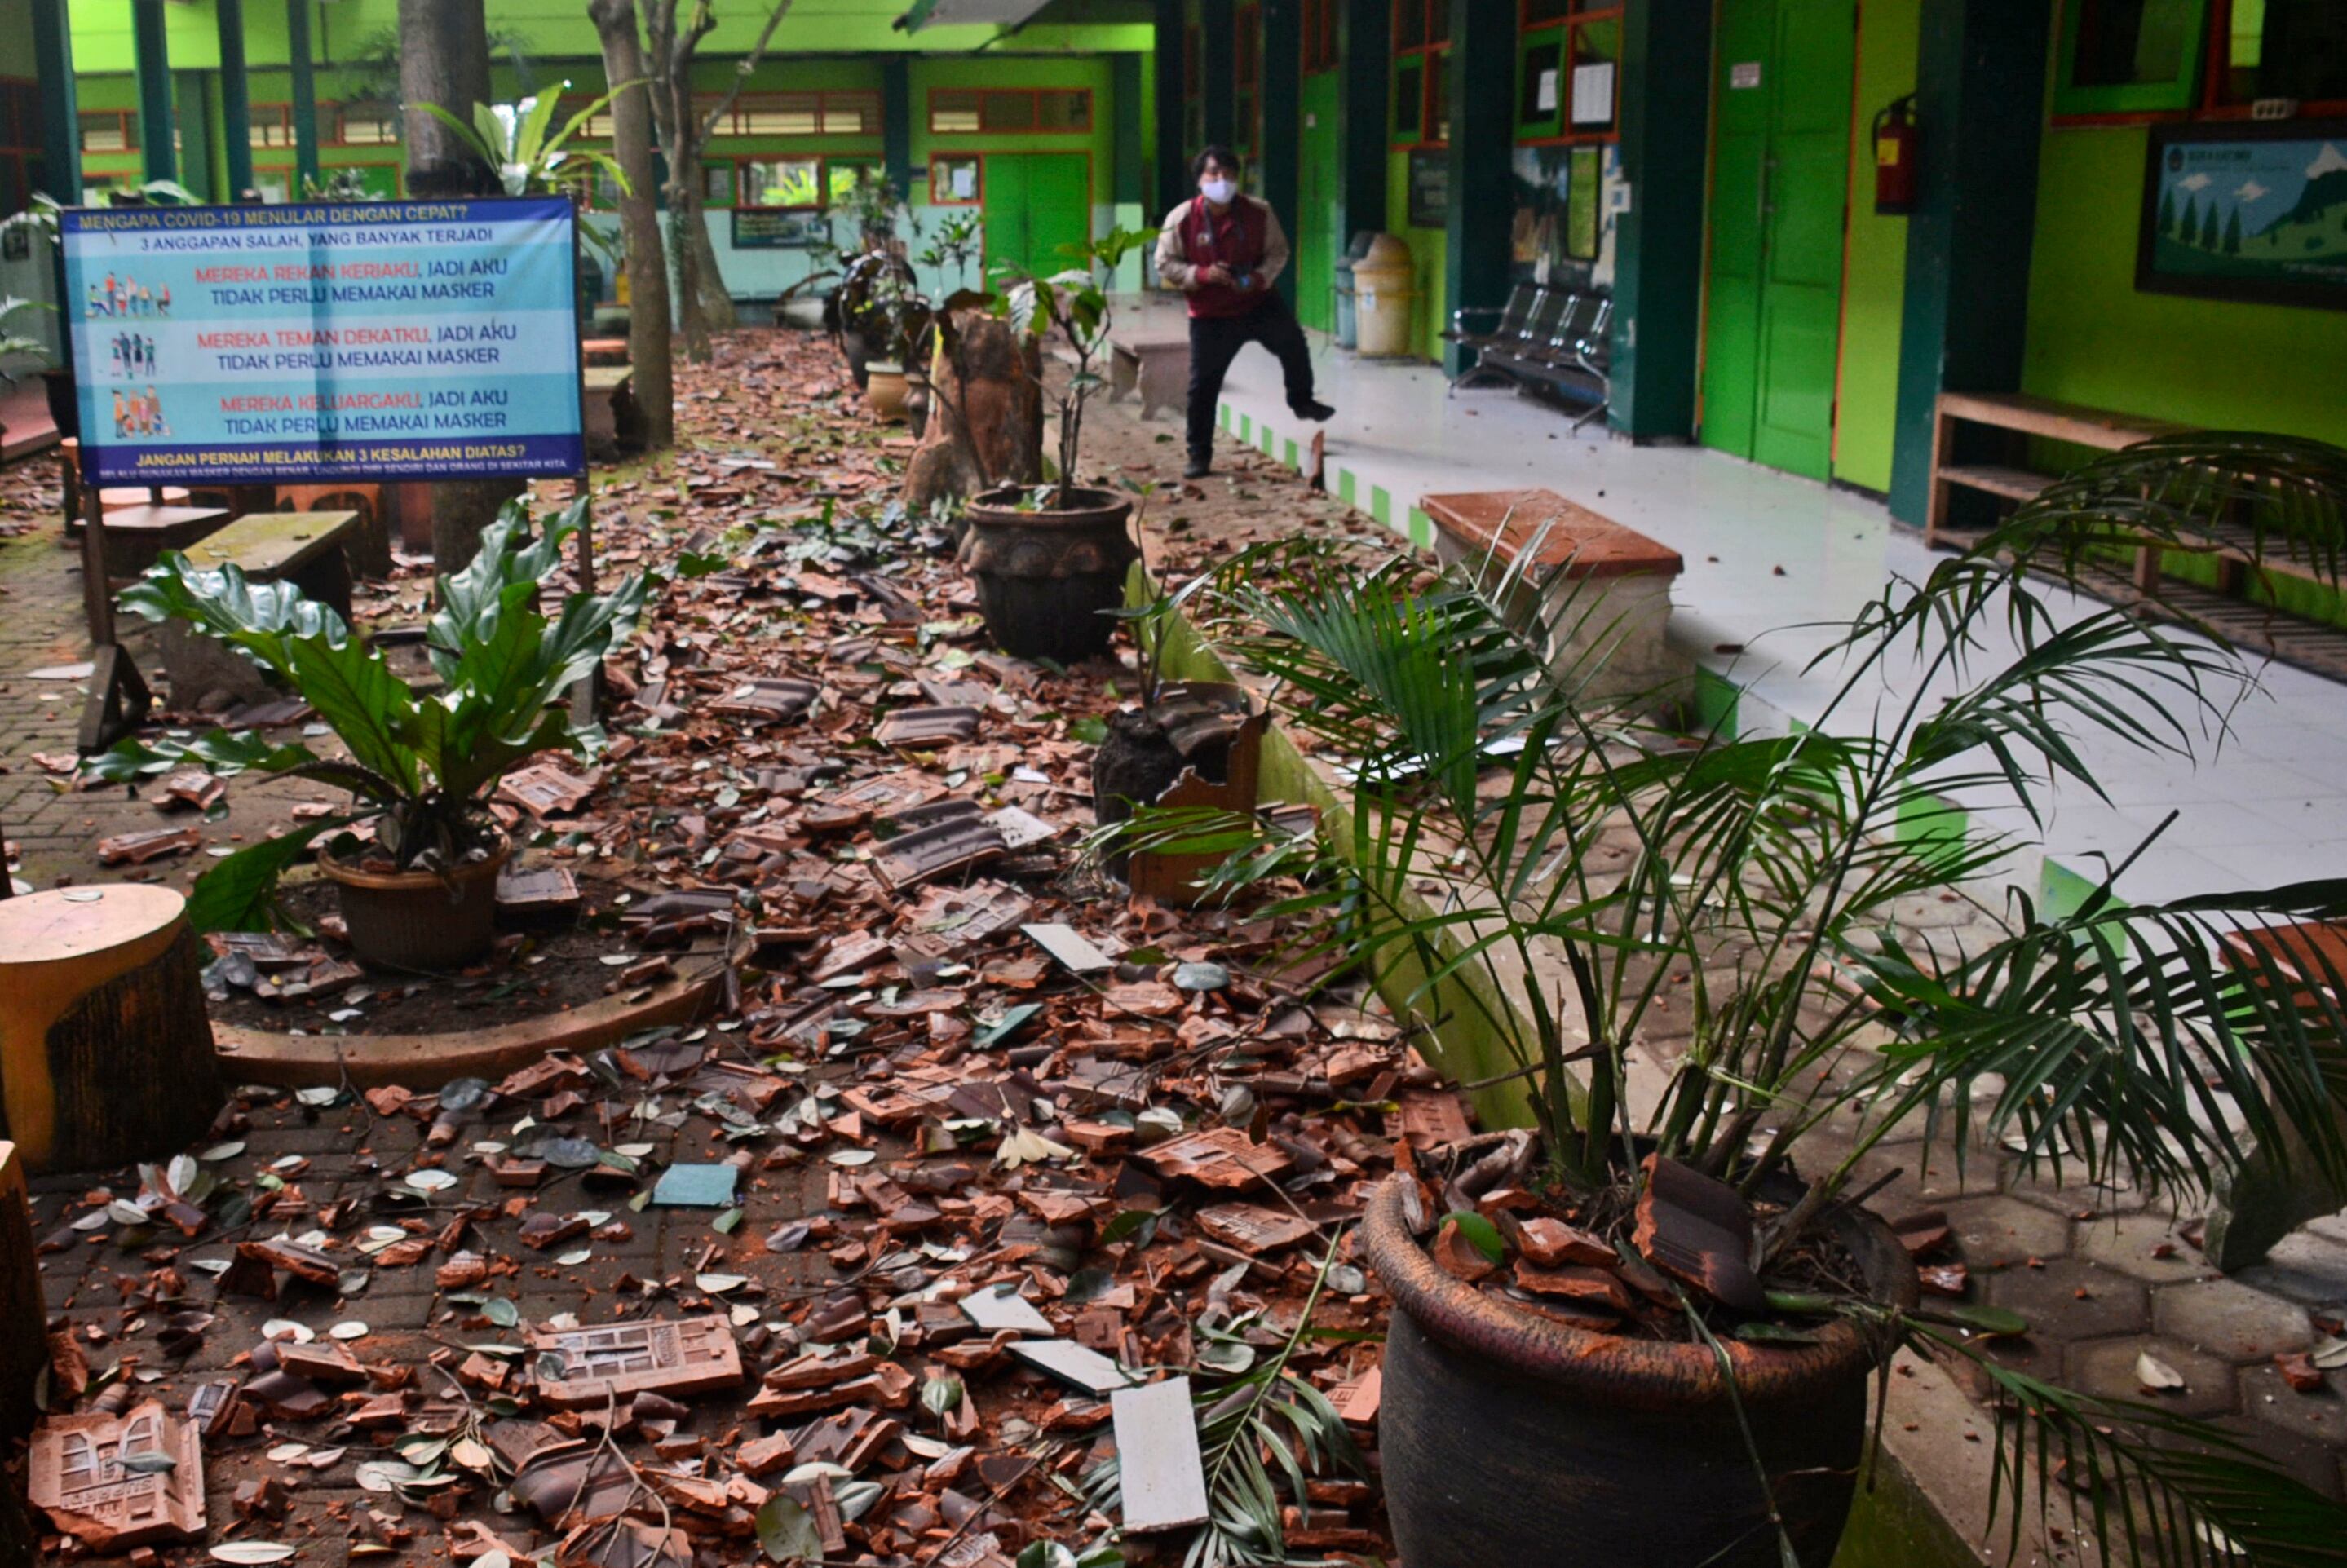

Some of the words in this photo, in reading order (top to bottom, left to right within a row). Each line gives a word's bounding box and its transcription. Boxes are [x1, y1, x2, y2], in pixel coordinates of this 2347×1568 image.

[79, 214, 161, 230] MENGAPA
[163, 212, 241, 228] COVID-19
[244, 209, 326, 226] MENULAR
[330, 206, 401, 223] DENGAN
[405, 204, 469, 221] CEPAT?
[140, 237, 148, 251] 3
[153, 234, 241, 250] ANGGAPAN
[245, 233, 305, 249] SALAH,
[308, 230, 351, 246] YANG
[356, 229, 422, 244] BANYAK
[427, 227, 493, 242] TERJADI
[195, 265, 270, 283] MEREKA
[274, 263, 336, 281] REKAN
[427, 259, 465, 277] JADI
[470, 258, 508, 276] AKU
[211, 288, 264, 305] TIDAK
[269, 286, 327, 304] PERLU
[332, 285, 417, 303] MEMAKAI
[422, 281, 495, 298] MASKER
[197, 329, 271, 349] MEREKA
[276, 328, 339, 347] TEMAN
[438, 325, 474, 342] JADI
[479, 323, 517, 341] AKU
[217, 354, 270, 371] TIDAK
[275, 352, 333, 369] PERLU
[338, 350, 422, 368] MEMAKAI
[427, 347, 500, 364] MASKER
[220, 395, 294, 413] MEREKA
[428, 391, 466, 409] JADI
[470, 389, 509, 406] AKU
[224, 418, 278, 435] TIDAK
[282, 416, 339, 434] PERLU
[344, 413, 428, 432] MEMAKAI
[433, 411, 506, 430] MASKER
[135, 452, 196, 467] JANGAN
[200, 450, 260, 466] PERNAH
[263, 448, 355, 465] MELAKUKAN
[359, 448, 367, 462] 3
[370, 446, 462, 462] KESALAHAN
[465, 444, 526, 460] DIATAS?
[384, 462, 423, 474] SENDIRI
[426, 462, 448, 472] DAN
[450, 461, 486, 472] ORANG
[488, 461, 498, 471] DI
[500, 460, 542, 470] SEKITAR
[544, 459, 568, 469] KITA
